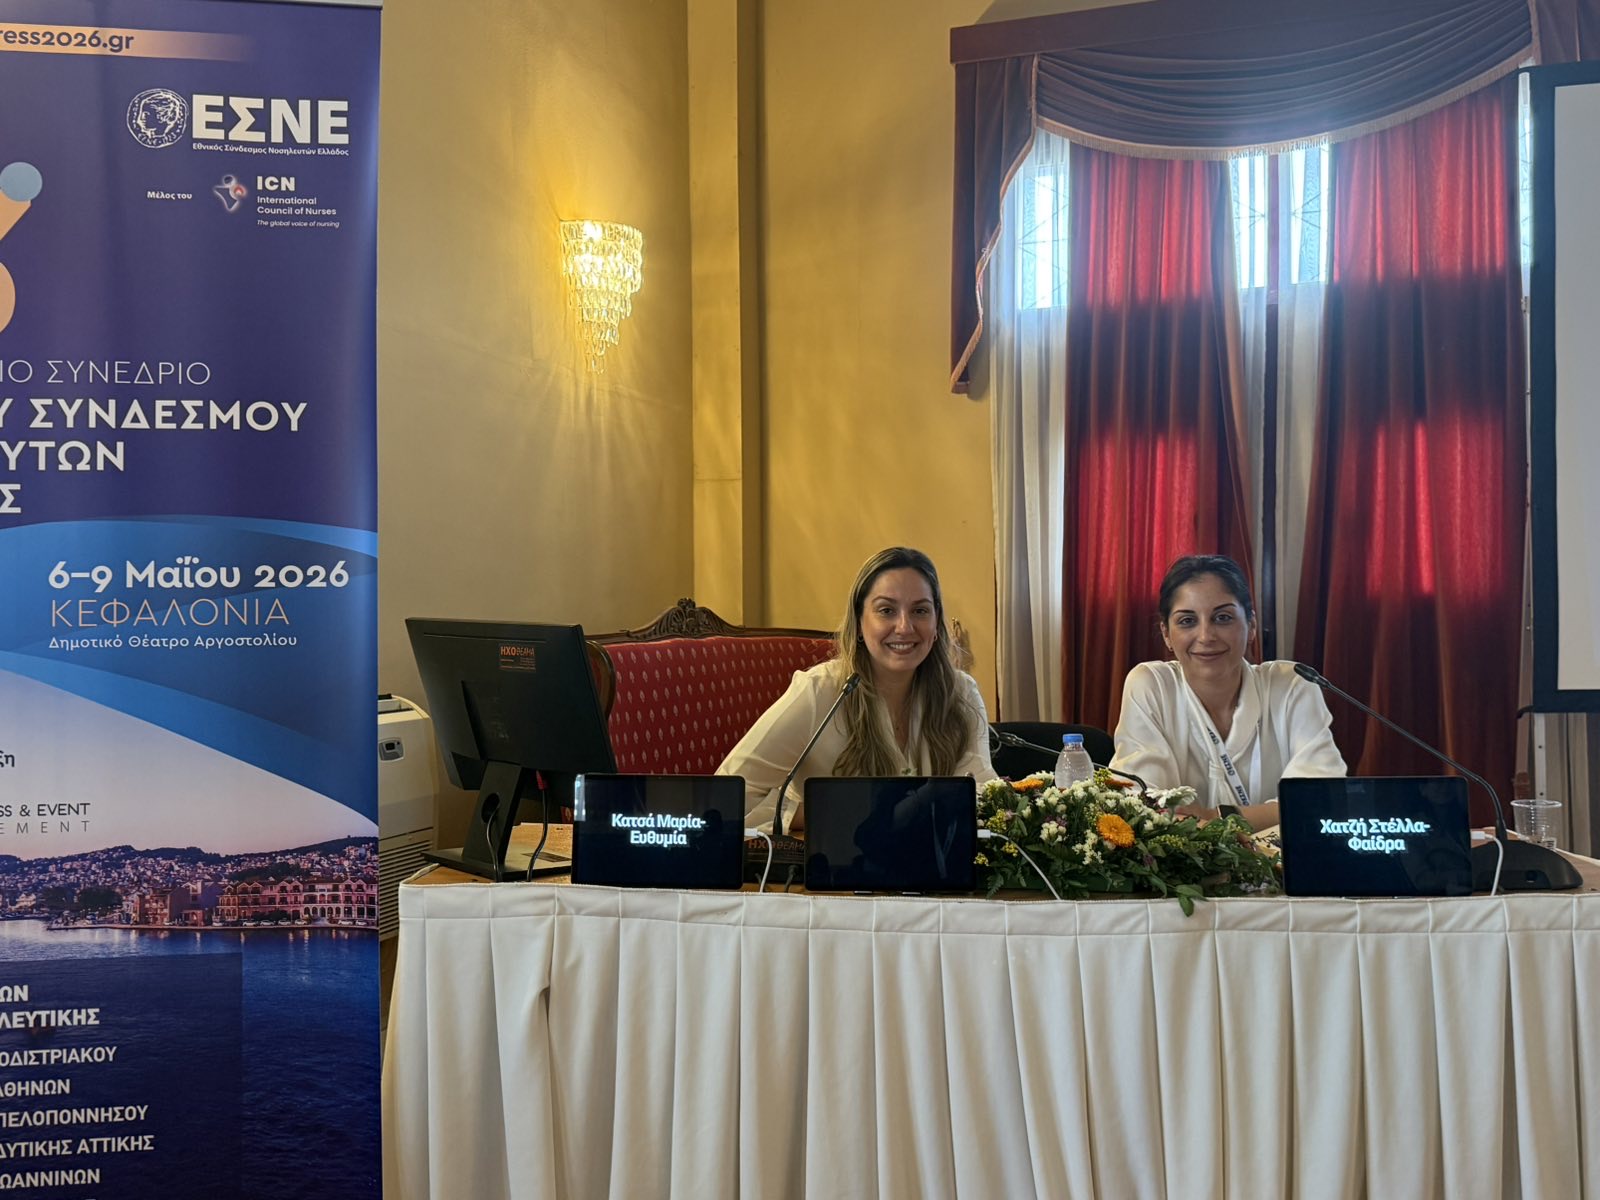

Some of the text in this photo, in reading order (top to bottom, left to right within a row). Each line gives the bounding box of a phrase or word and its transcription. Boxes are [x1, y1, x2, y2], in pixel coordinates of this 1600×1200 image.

[192, 94, 349, 145] ΕΣΝΕ
[192, 143, 349, 156] Εθνικός Σύνδεσμος Νοσηλευτών Ελλάδος
[257, 176, 296, 191] ICN
[147, 190, 175, 200] Μέλος
[257, 196, 317, 205] International
[257, 206, 293, 215] Council
[316, 221, 340, 229] nursing
[47, 360, 211, 385] ΣΥΝΕΔΡΙΟ
[29, 398, 307, 432] ΣΥΝΔΕΣΜΟΥ
[0, 441, 124, 471] ΥΤΩΝ
[126, 556, 241, 588] Μαΐου
[254, 560, 349, 588] 2026
[52, 598, 290, 628] ΚΕΦΑΛΟΝΙΑ
[49, 632, 297, 651] Δημοτικό Θέατρο Αργοστολίου
[19, 804, 31, 817] &
[37, 802, 91, 817] EVENT
[611, 813, 706, 831] Κατσά Μαρία-
[1320, 817, 1431, 836] Χατζή Στέλλα-
[630, 830, 687, 848] Ευθυμία
[1348, 835, 1406, 854] Φαίδρα
[0, 985, 29, 1002] ΩΝ
[0, 1008, 100, 1029] ΛΕΥΤΙΚΗΣ
[0, 1046, 117, 1067] ΟΔΙΣΤΡΙΑΚΟΥ
[77, 1135, 155, 1154] ΑΤΤΙΚΗΣ
[0, 1168, 100, 1189] ΩΑΝΝΙΝΩΝ
